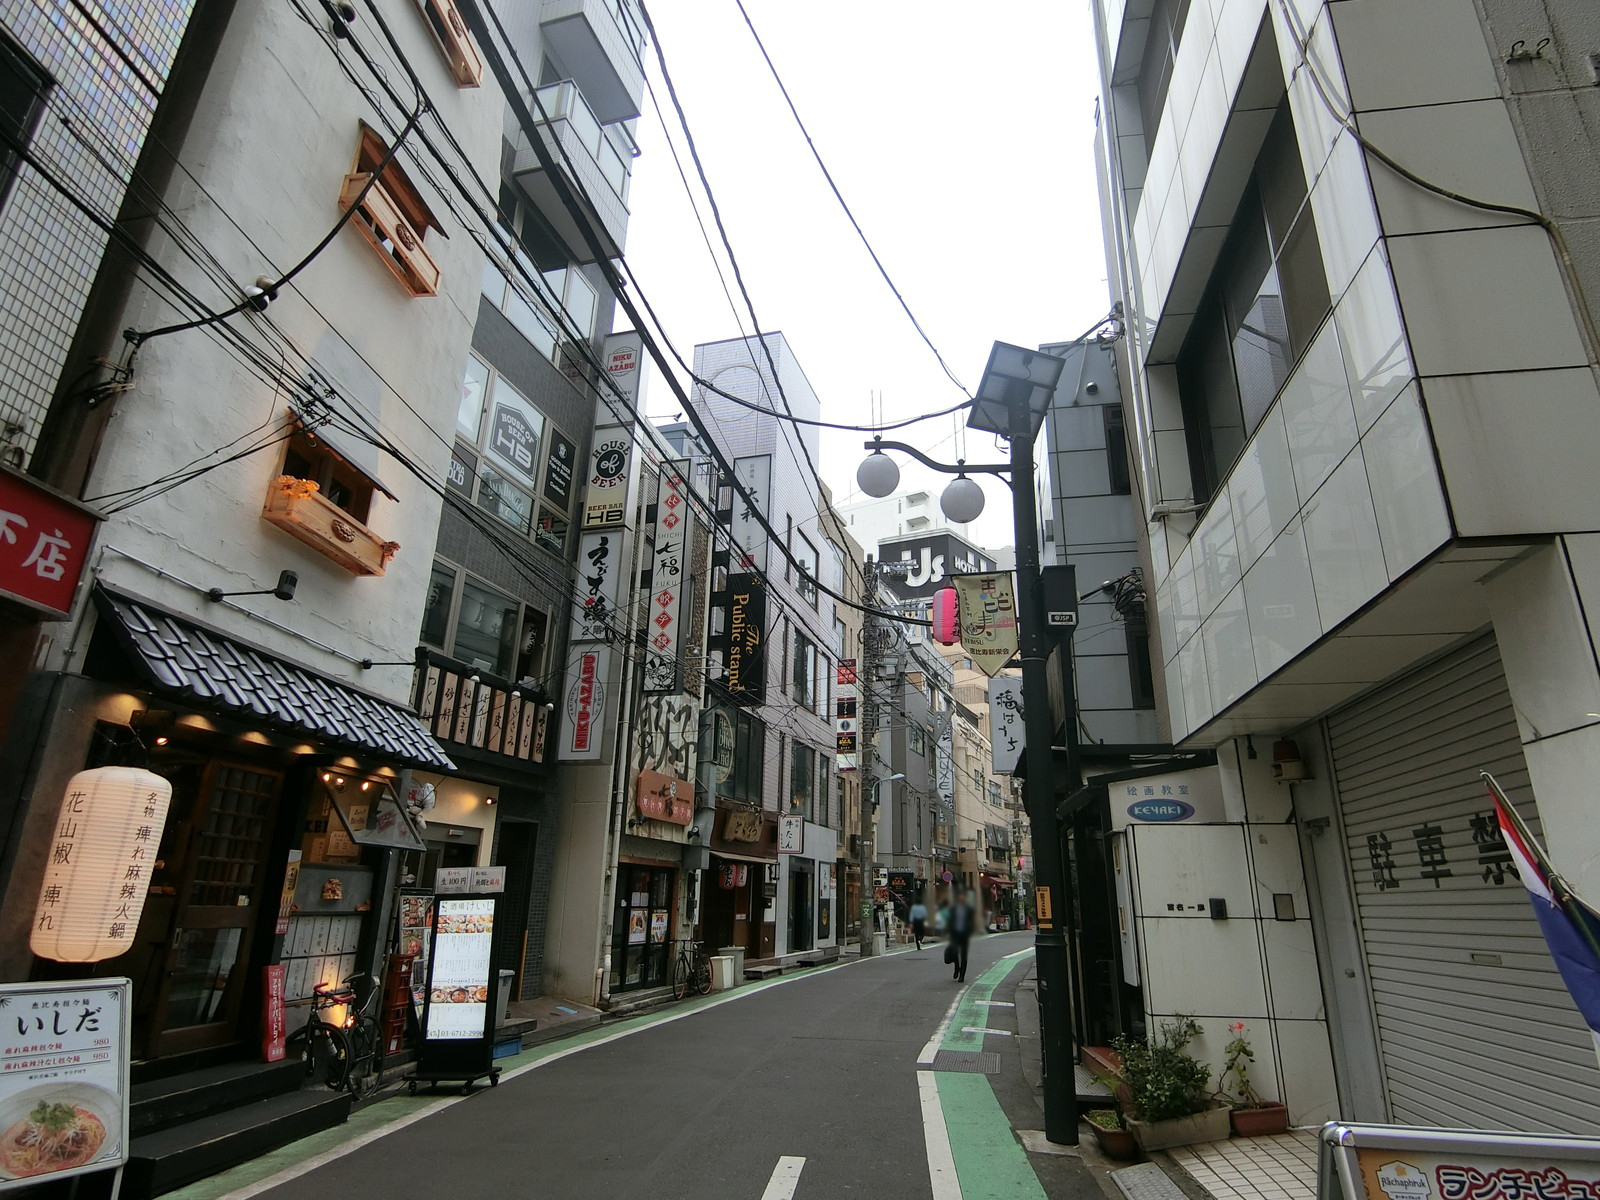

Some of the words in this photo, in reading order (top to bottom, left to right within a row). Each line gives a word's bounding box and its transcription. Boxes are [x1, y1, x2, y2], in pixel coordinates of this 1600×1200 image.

[612, 353, 632, 362] NIKU
[608, 362, 635, 372] AZABU
[500, 412, 525, 434] HOUSE
[508, 424, 527, 447] BEER
[496, 427, 532, 470] HB
[592, 440, 631, 460] HOUSE
[600, 453, 620, 474] of
[591, 472, 628, 488] BEER
[587, 504, 607, 512] BEER
[608, 502, 623, 510] BAR
[586, 509, 624, 525] HB
[657, 531, 683, 540] SHICHI
[655, 580, 678, 588] FUKU
[731, 593, 750, 642] Public
[728, 646, 746, 692] stand
[1126, 785, 1190, 796] 絵画教室
[143, 791, 159, 818] 名物
[1133, 805, 1182, 816] KEYAKI
[784, 819, 794, 850] 牛たん
[17, 1006, 103, 1037] いしだ
[93, 1037, 110, 1046] 980
[92, 1051, 110, 1061] 980
